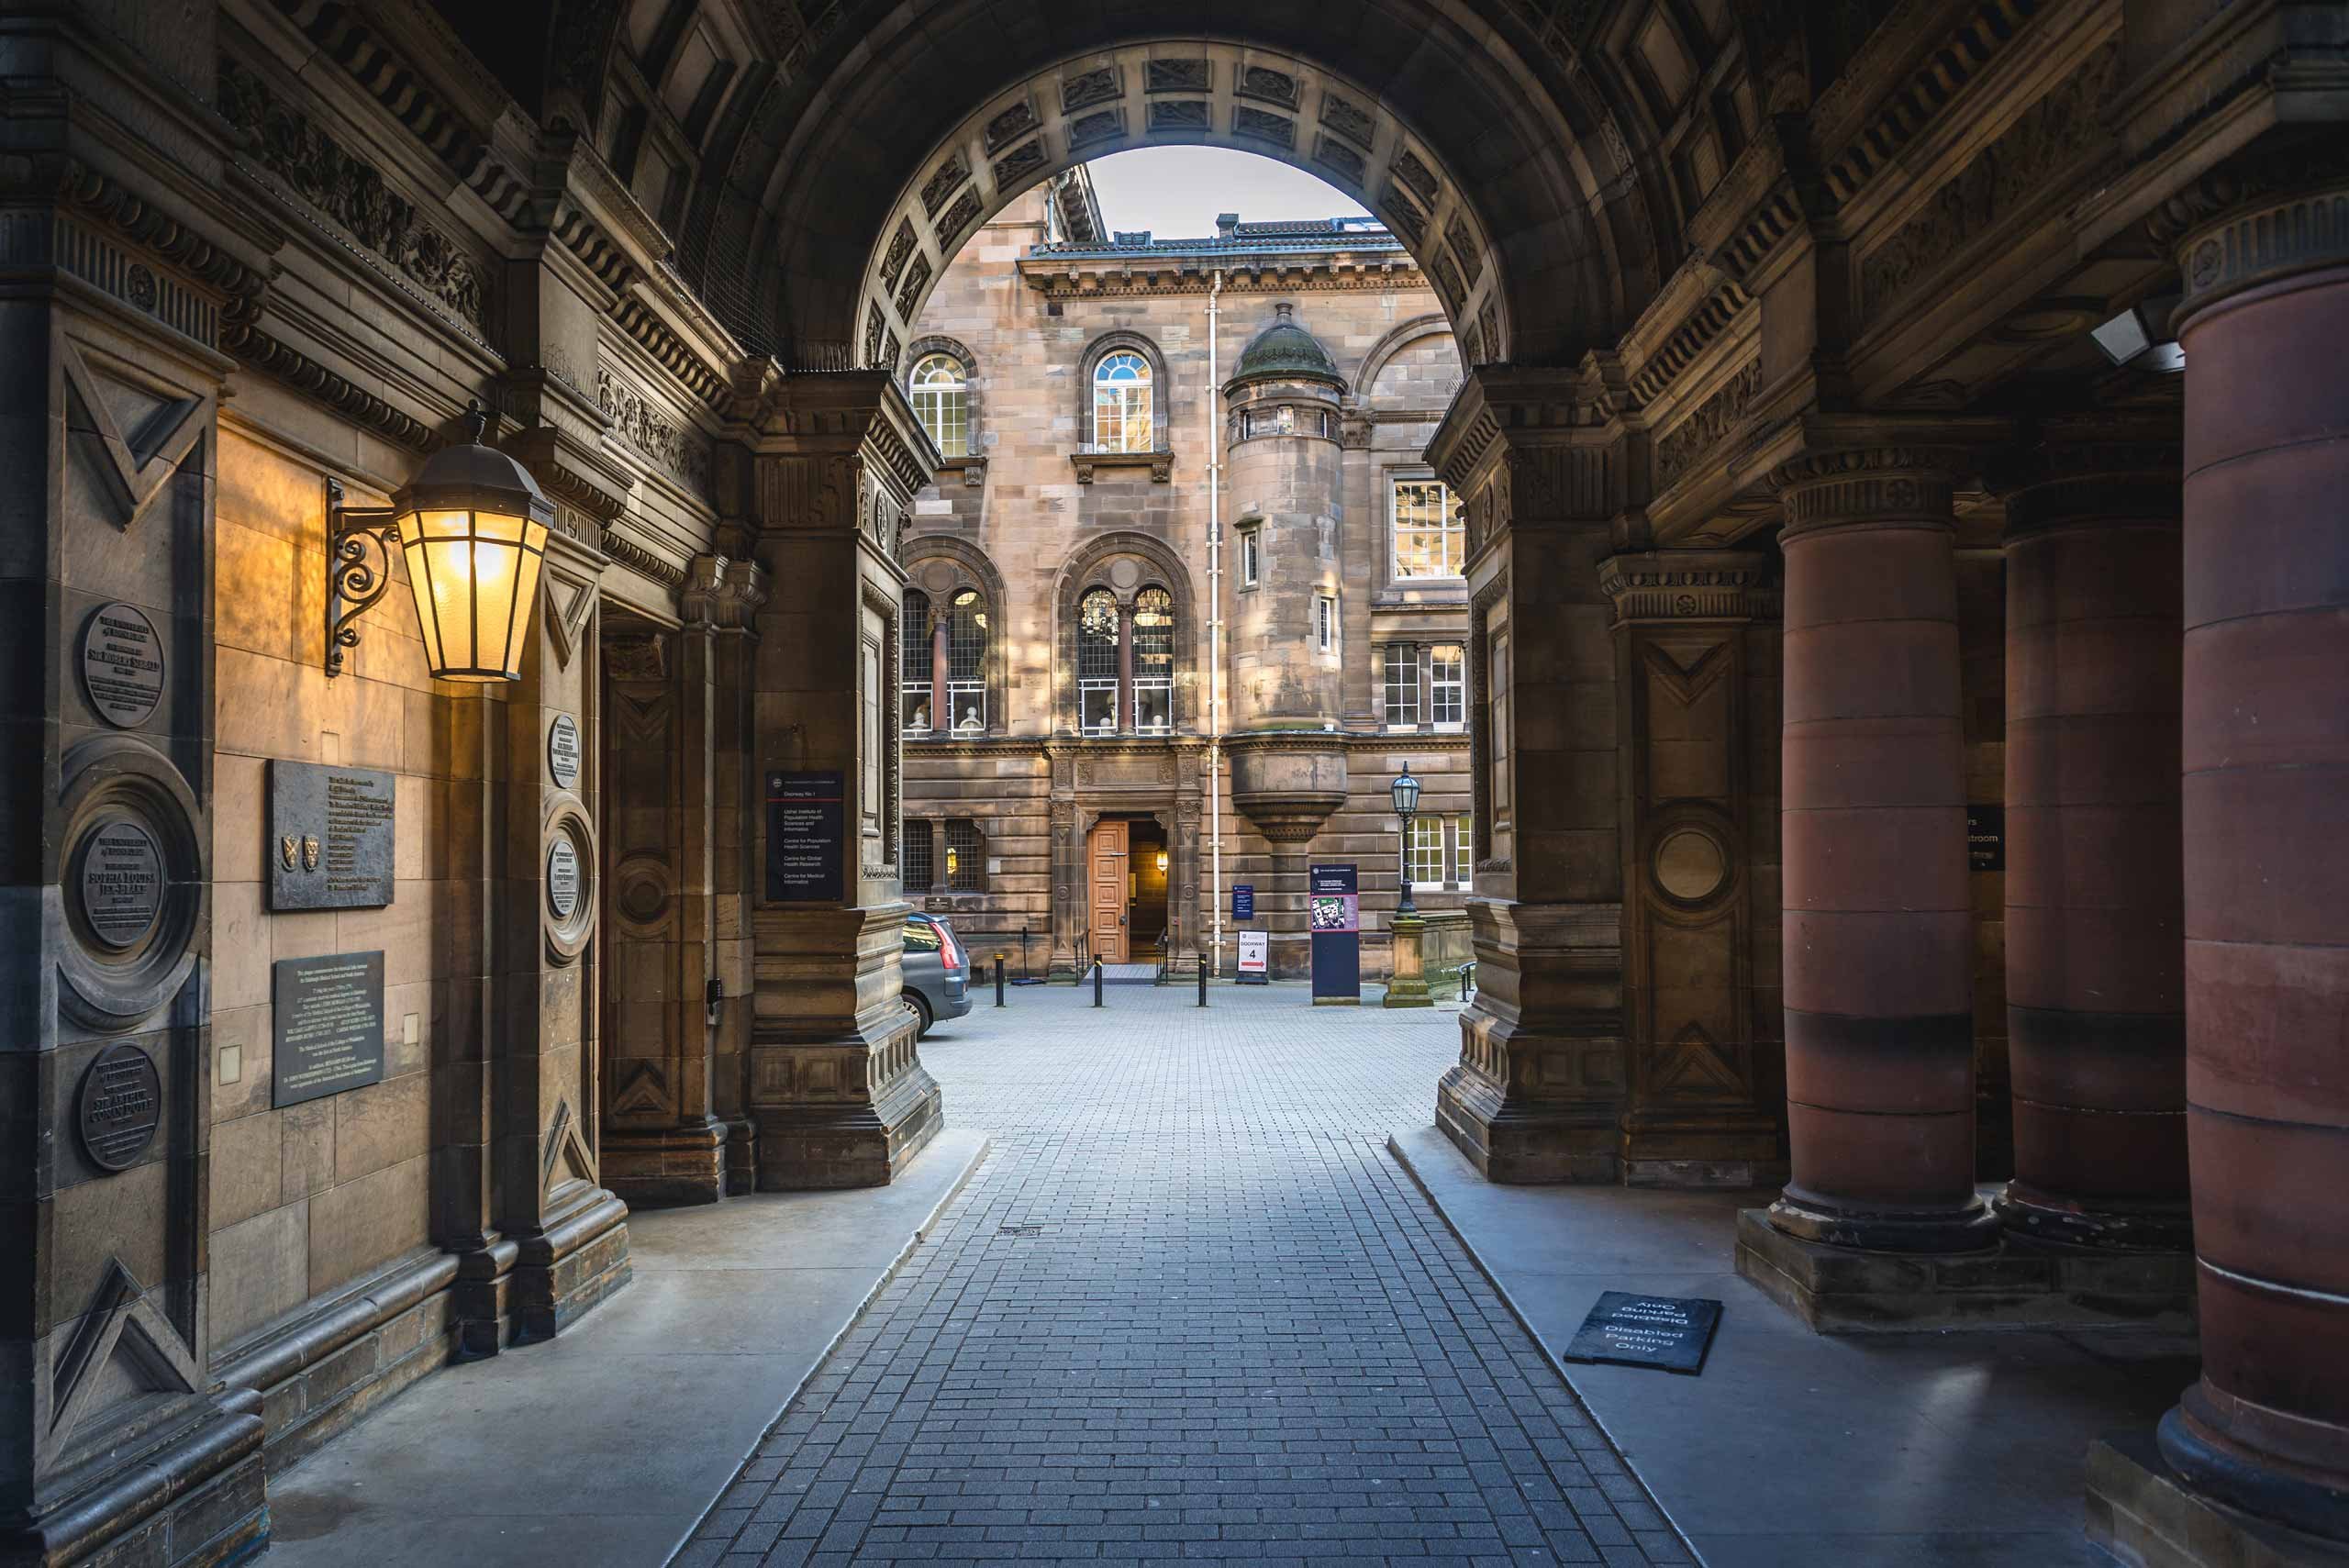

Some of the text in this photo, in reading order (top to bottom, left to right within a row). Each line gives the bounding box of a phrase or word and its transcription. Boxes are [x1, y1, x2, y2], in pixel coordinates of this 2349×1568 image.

[1249, 949, 1256, 959] 4
[1621, 1307, 1687, 1318] Parking
[1611, 1313, 1688, 1324] Disabled
[1605, 1326, 1684, 1338] Disabled
[1606, 1333, 1674, 1346] Parking
[1615, 1342, 1657, 1351] Only
